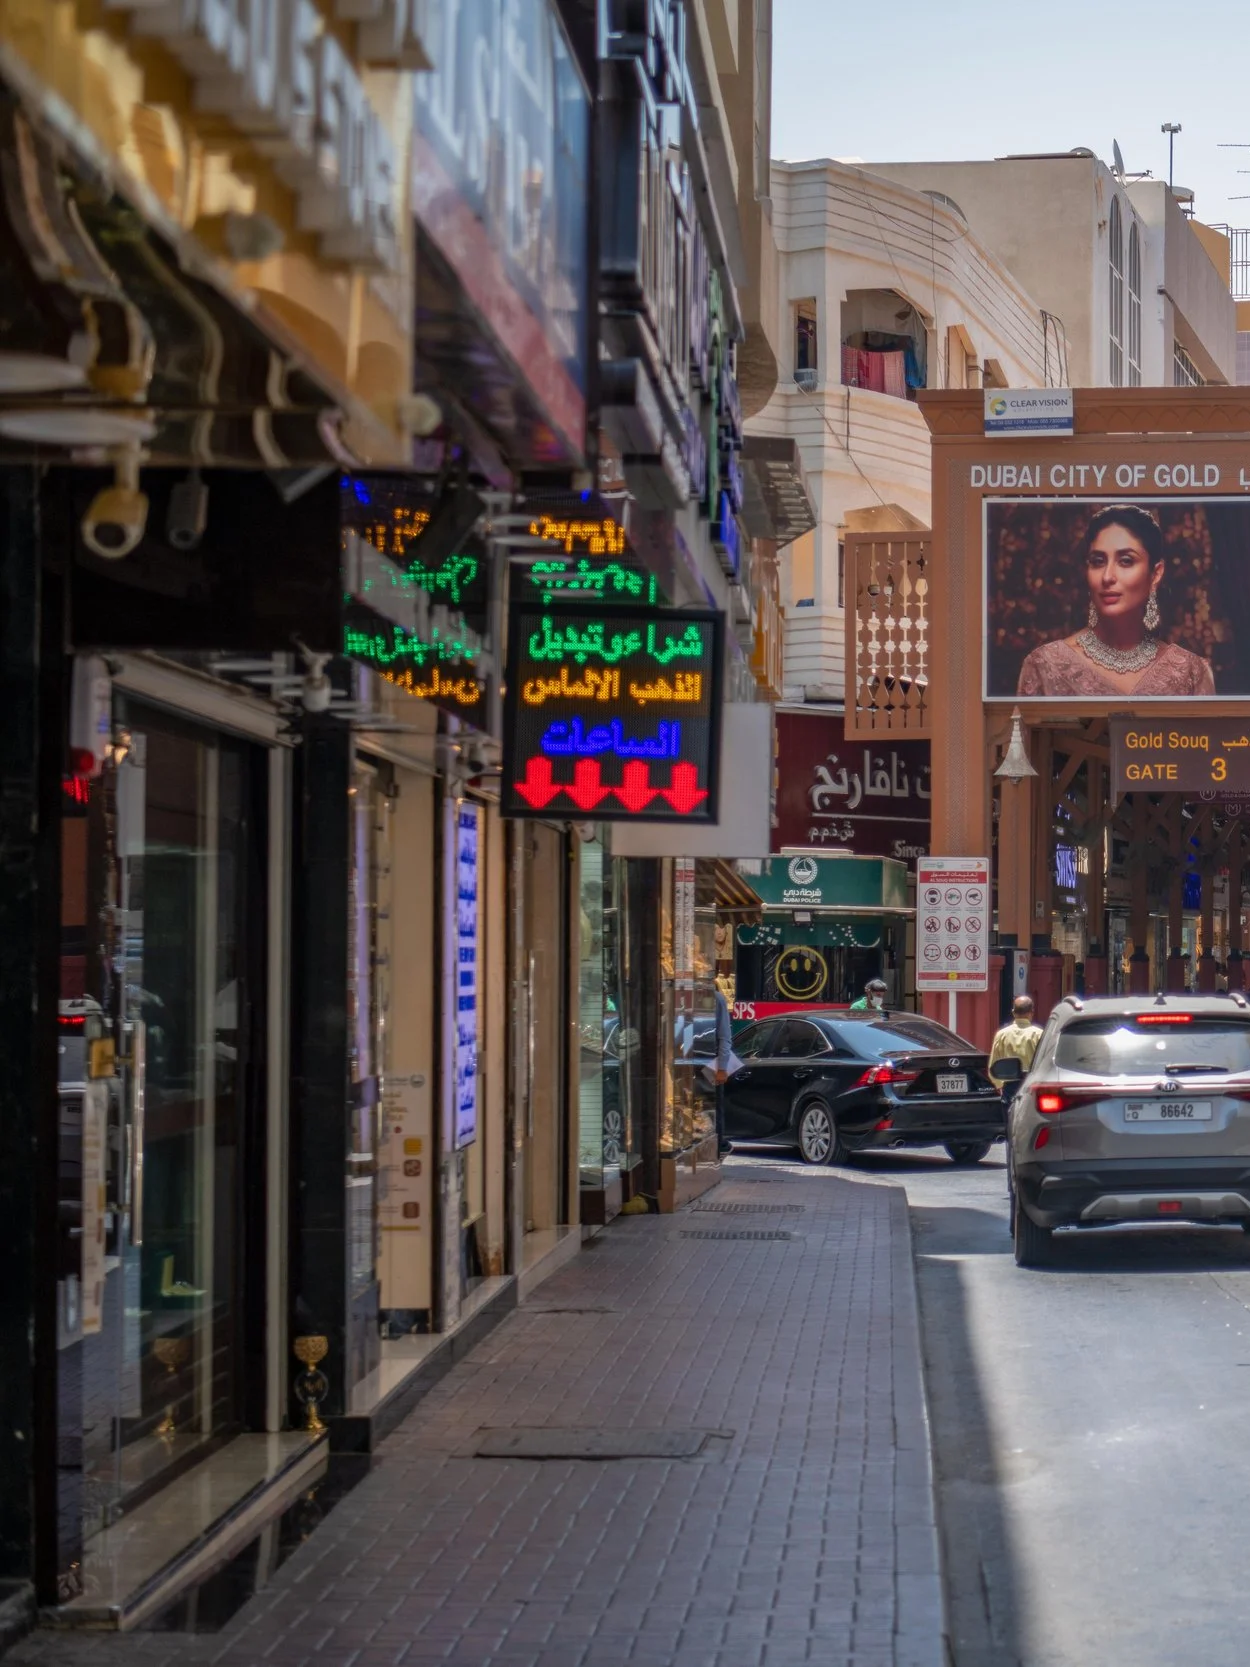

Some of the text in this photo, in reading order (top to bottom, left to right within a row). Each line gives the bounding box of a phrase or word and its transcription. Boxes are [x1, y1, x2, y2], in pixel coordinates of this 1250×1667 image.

[1010, 398, 1068, 408] CLEAR VISION
[970, 464, 1220, 488] DUBAI CITY OF GOLD
[629, 672, 701, 705] الذهب
[541, 716, 681, 758] الساعات
[1125, 731, 1209, 752] Gold Souq
[1126, 764, 1178, 780] GATE
[1211, 757, 1227, 781] 3
[893, 840, 926, 858] Since
[783, 888, 822, 898] شرطة دبي
[941, 1080, 964, 1090] 37877
[1161, 1082, 1178, 1091] KIA
[1131, 1111, 1139, 1119] Q
[1160, 1104, 1194, 1118] 86642
